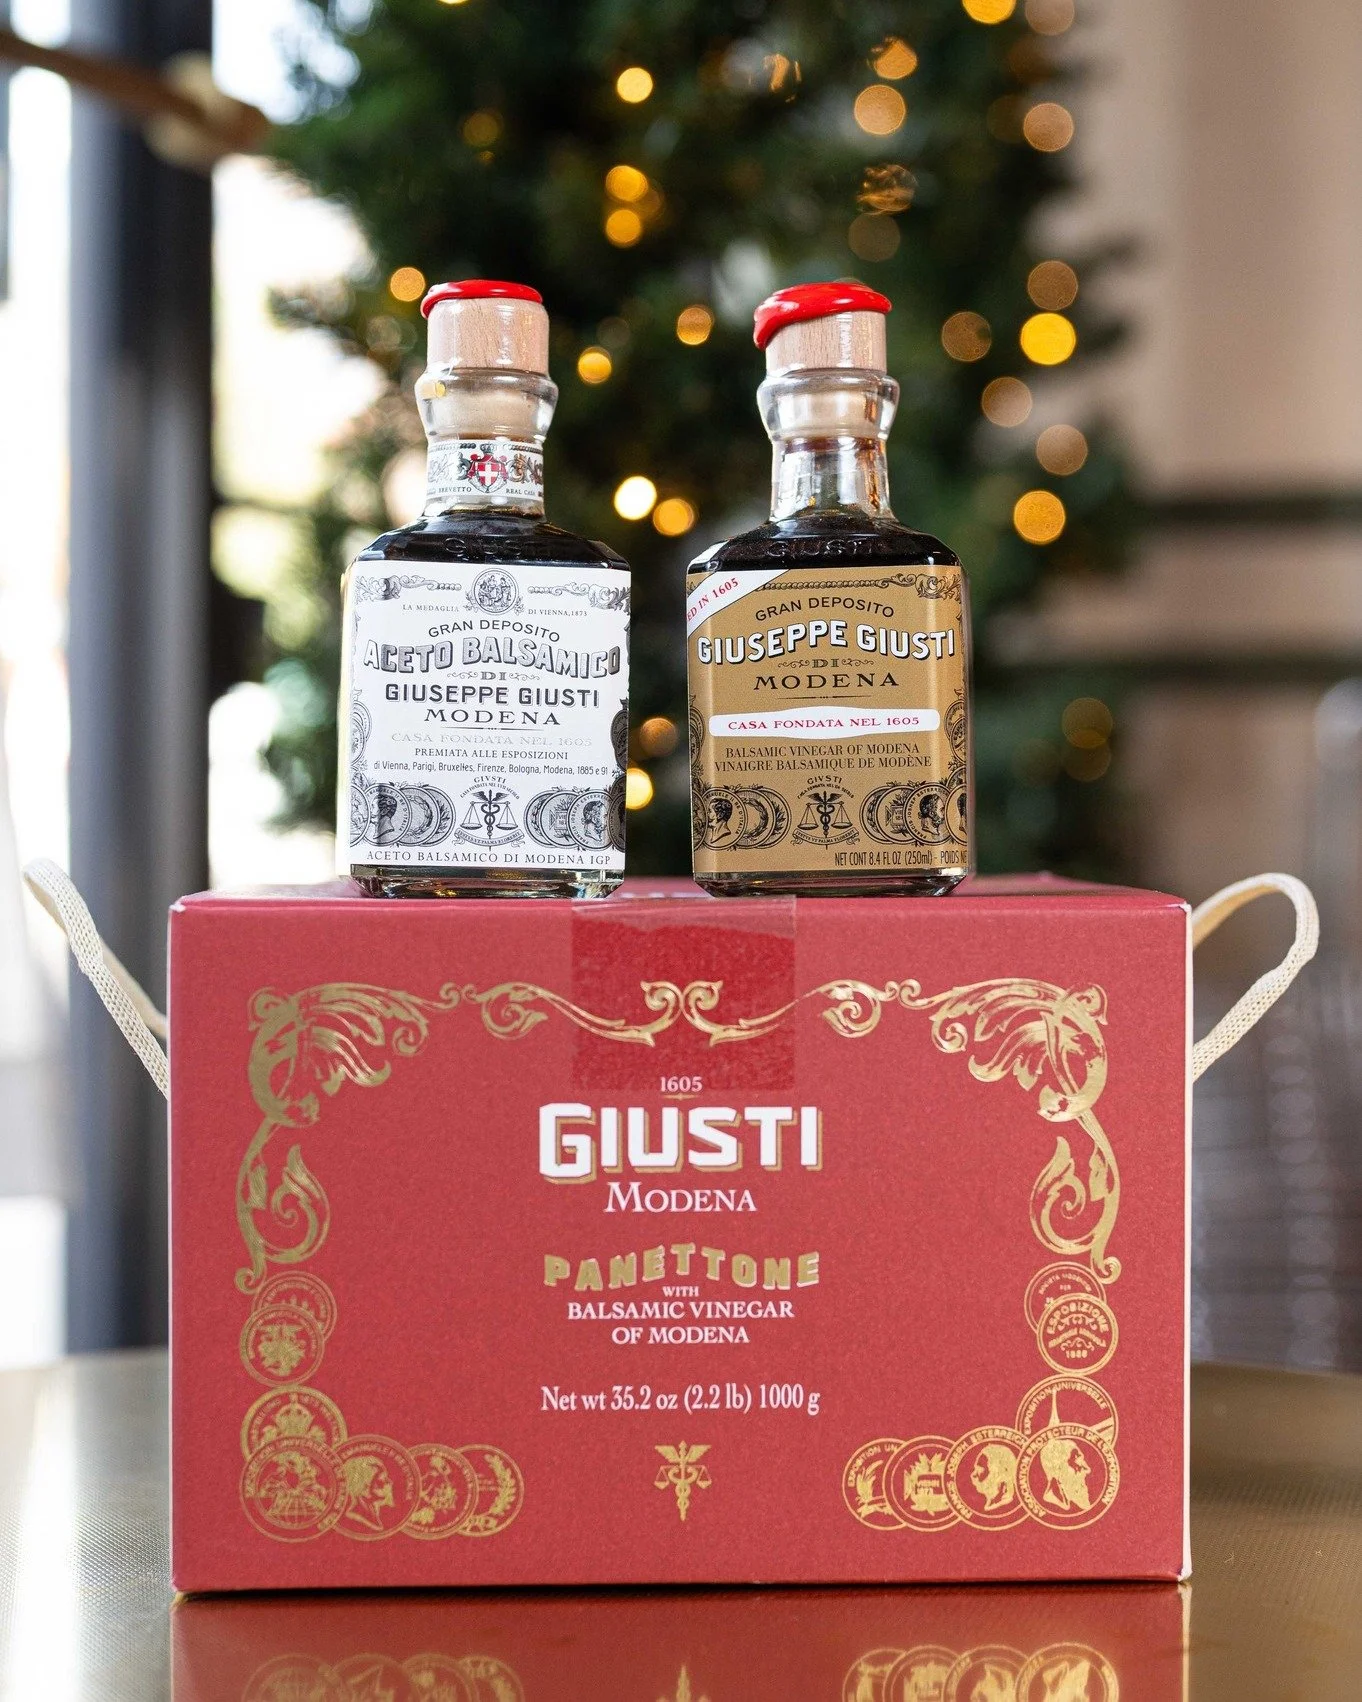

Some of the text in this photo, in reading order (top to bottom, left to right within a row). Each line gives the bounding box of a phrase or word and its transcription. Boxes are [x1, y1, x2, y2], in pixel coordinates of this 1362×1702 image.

[698, 596, 710, 608] IN
[712, 577, 740, 598] 1605
[416, 604, 460, 612] MEDAGLIA
[755, 597, 895, 621] GRAN DEPOSITO
[428, 619, 560, 643] GRAN DEPOSITO
[696, 619, 956, 666] GIUSEPPE GIUSTI
[363, 636, 621, 680] ACETO BALSAMICO
[811, 658, 840, 668] DI
[480, 671, 507, 681] DI
[753, 672, 899, 690] MODENA
[385, 683, 600, 708] GIUSEPPE GIUSTI
[424, 708, 561, 726] MODENA
[727, 716, 920, 730] CASA FONDATA NEL 1605
[391, 732, 434, 743] CASA
[440, 734, 514, 746] FONDATA
[415, 748, 569, 760] PREMIATA ALLE ESPOSIZIONI
[725, 744, 920, 758] BALSAMIC VINEGAR OF MODENA
[374, 760, 380, 770] di
[381, 761, 410, 772] Vienna,
[412, 762, 437, 774] Parigi,
[438, 762, 476, 774] Bruxelles,
[477, 764, 506, 774] Firenze,
[509, 764, 542, 777] Bologna,
[543, 765, 575, 776] Modena,
[577, 766, 594, 775] 1885
[714, 755, 932, 772] VINAIGRE BALSAMIQUE DE MODÈNE
[474, 776, 506, 784] GIVSTI
[807, 775, 842, 784] GIVSTI
[367, 850, 612, 865] ACETO BALSAMICO DI MODENA IGP
[834, 852, 848, 866] NET
[849, 852, 868, 866] CONT
[870, 852, 882, 866] 8.4
[883, 852, 892, 866] FL
[893, 852, 902, 865] OZ
[904, 850, 933, 866] (250ml)
[940, 851, 959, 864] POIDS
[660, 1076, 703, 1092] 1605
[539, 1102, 823, 1184] GIUSTI
[544, 1242, 820, 1291] PANETTONE
[662, 1286, 699, 1297] WITH
[568, 1300, 795, 1320] BALSAMIC VINEGAR
[612, 1326, 750, 1344] OF MODENA
[541, 1382, 820, 1416] Net wt 35.2 oz (2.2 lb) 1000 g
